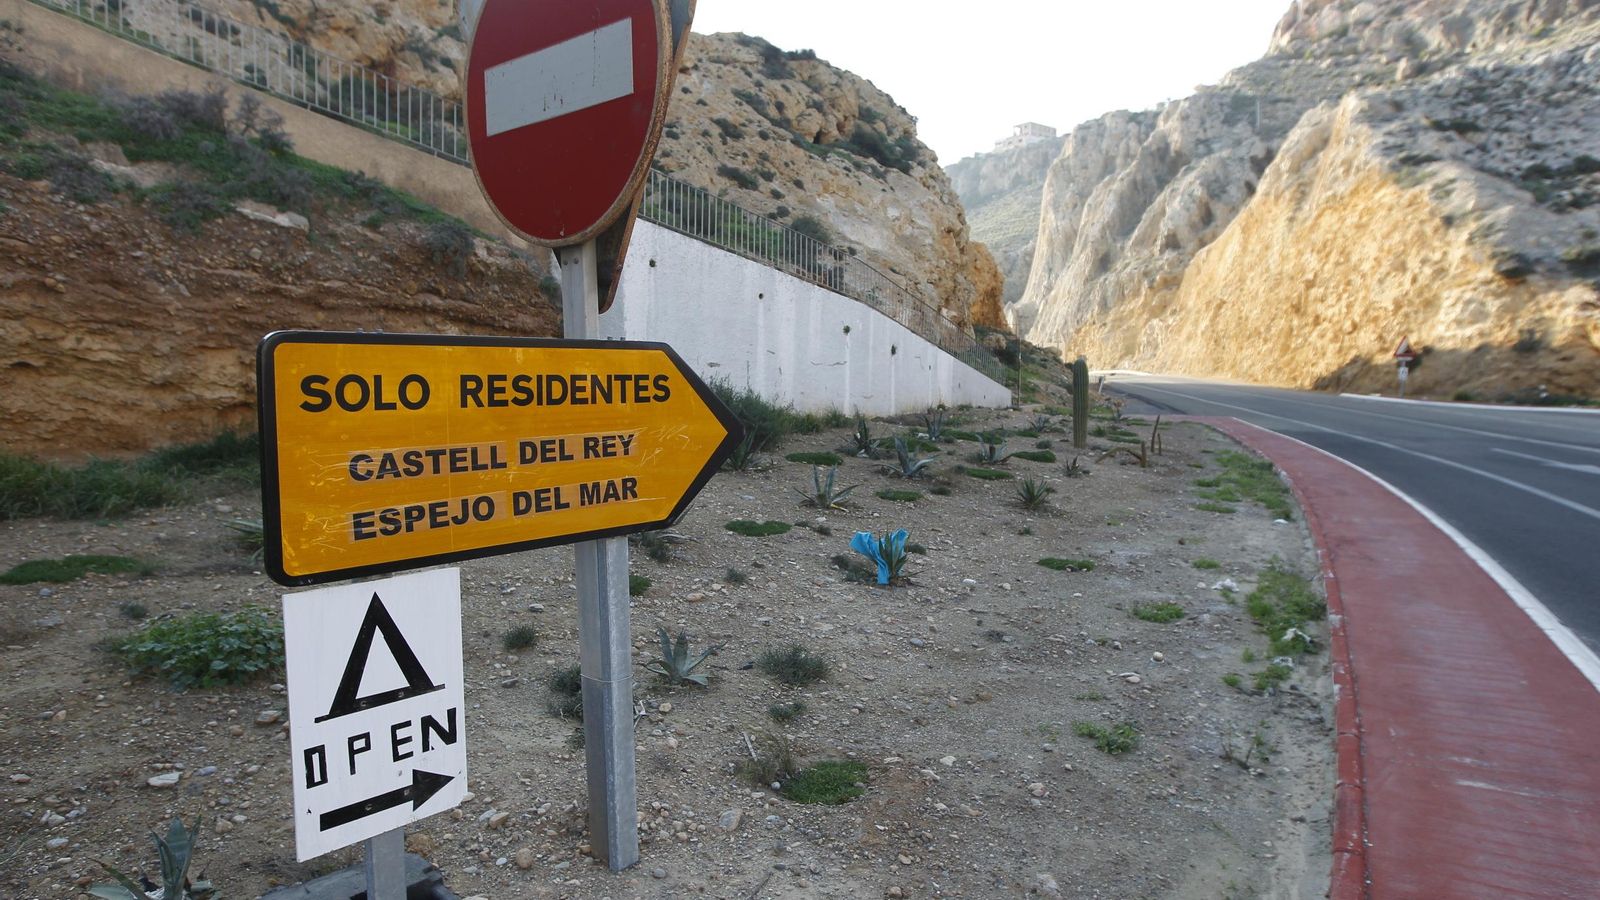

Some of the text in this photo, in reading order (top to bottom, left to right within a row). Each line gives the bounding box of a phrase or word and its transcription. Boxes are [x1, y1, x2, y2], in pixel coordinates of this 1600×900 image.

[299, 373, 671, 412] SOLO RESIDENTES
[348, 433, 635, 481] CASTELL DEL REY
[352, 476, 638, 541] ESPEJO DEL MAR
[303, 707, 458, 789] OPEN
